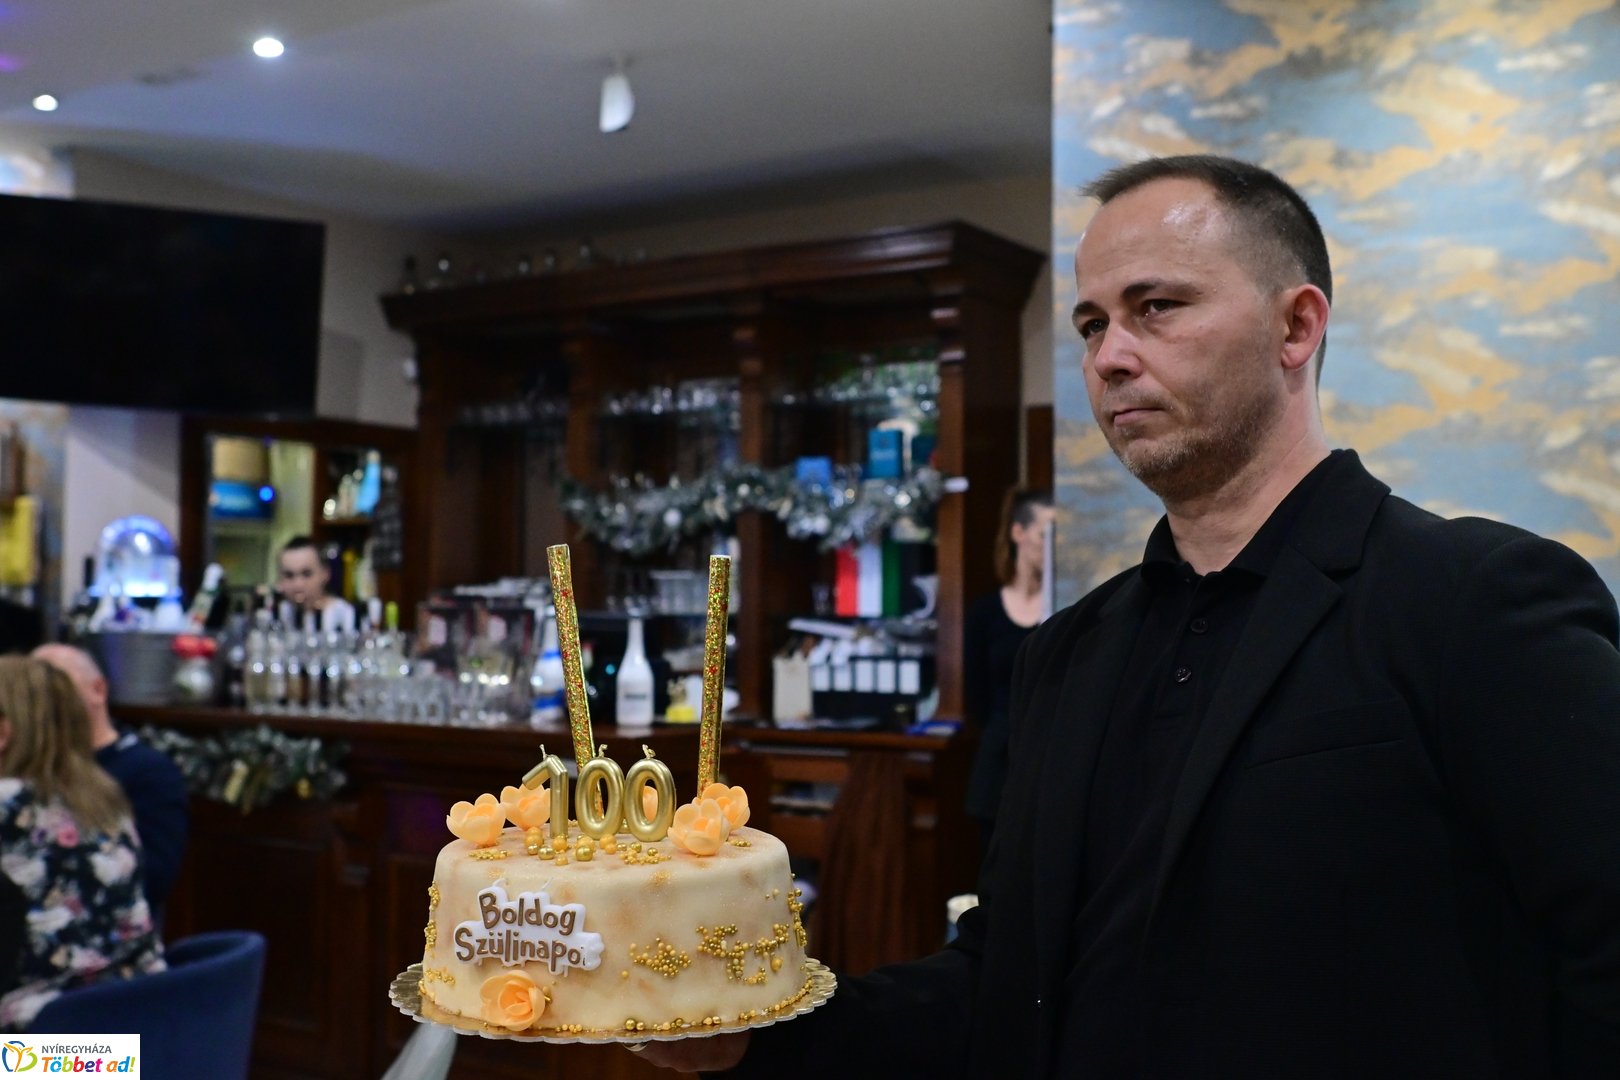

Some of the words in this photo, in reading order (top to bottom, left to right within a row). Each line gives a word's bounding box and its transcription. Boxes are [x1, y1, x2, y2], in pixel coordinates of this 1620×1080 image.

[522, 755, 676, 842] 100
[479, 893, 576, 936] Boldog
[455, 927, 587, 971] Szülinapo
